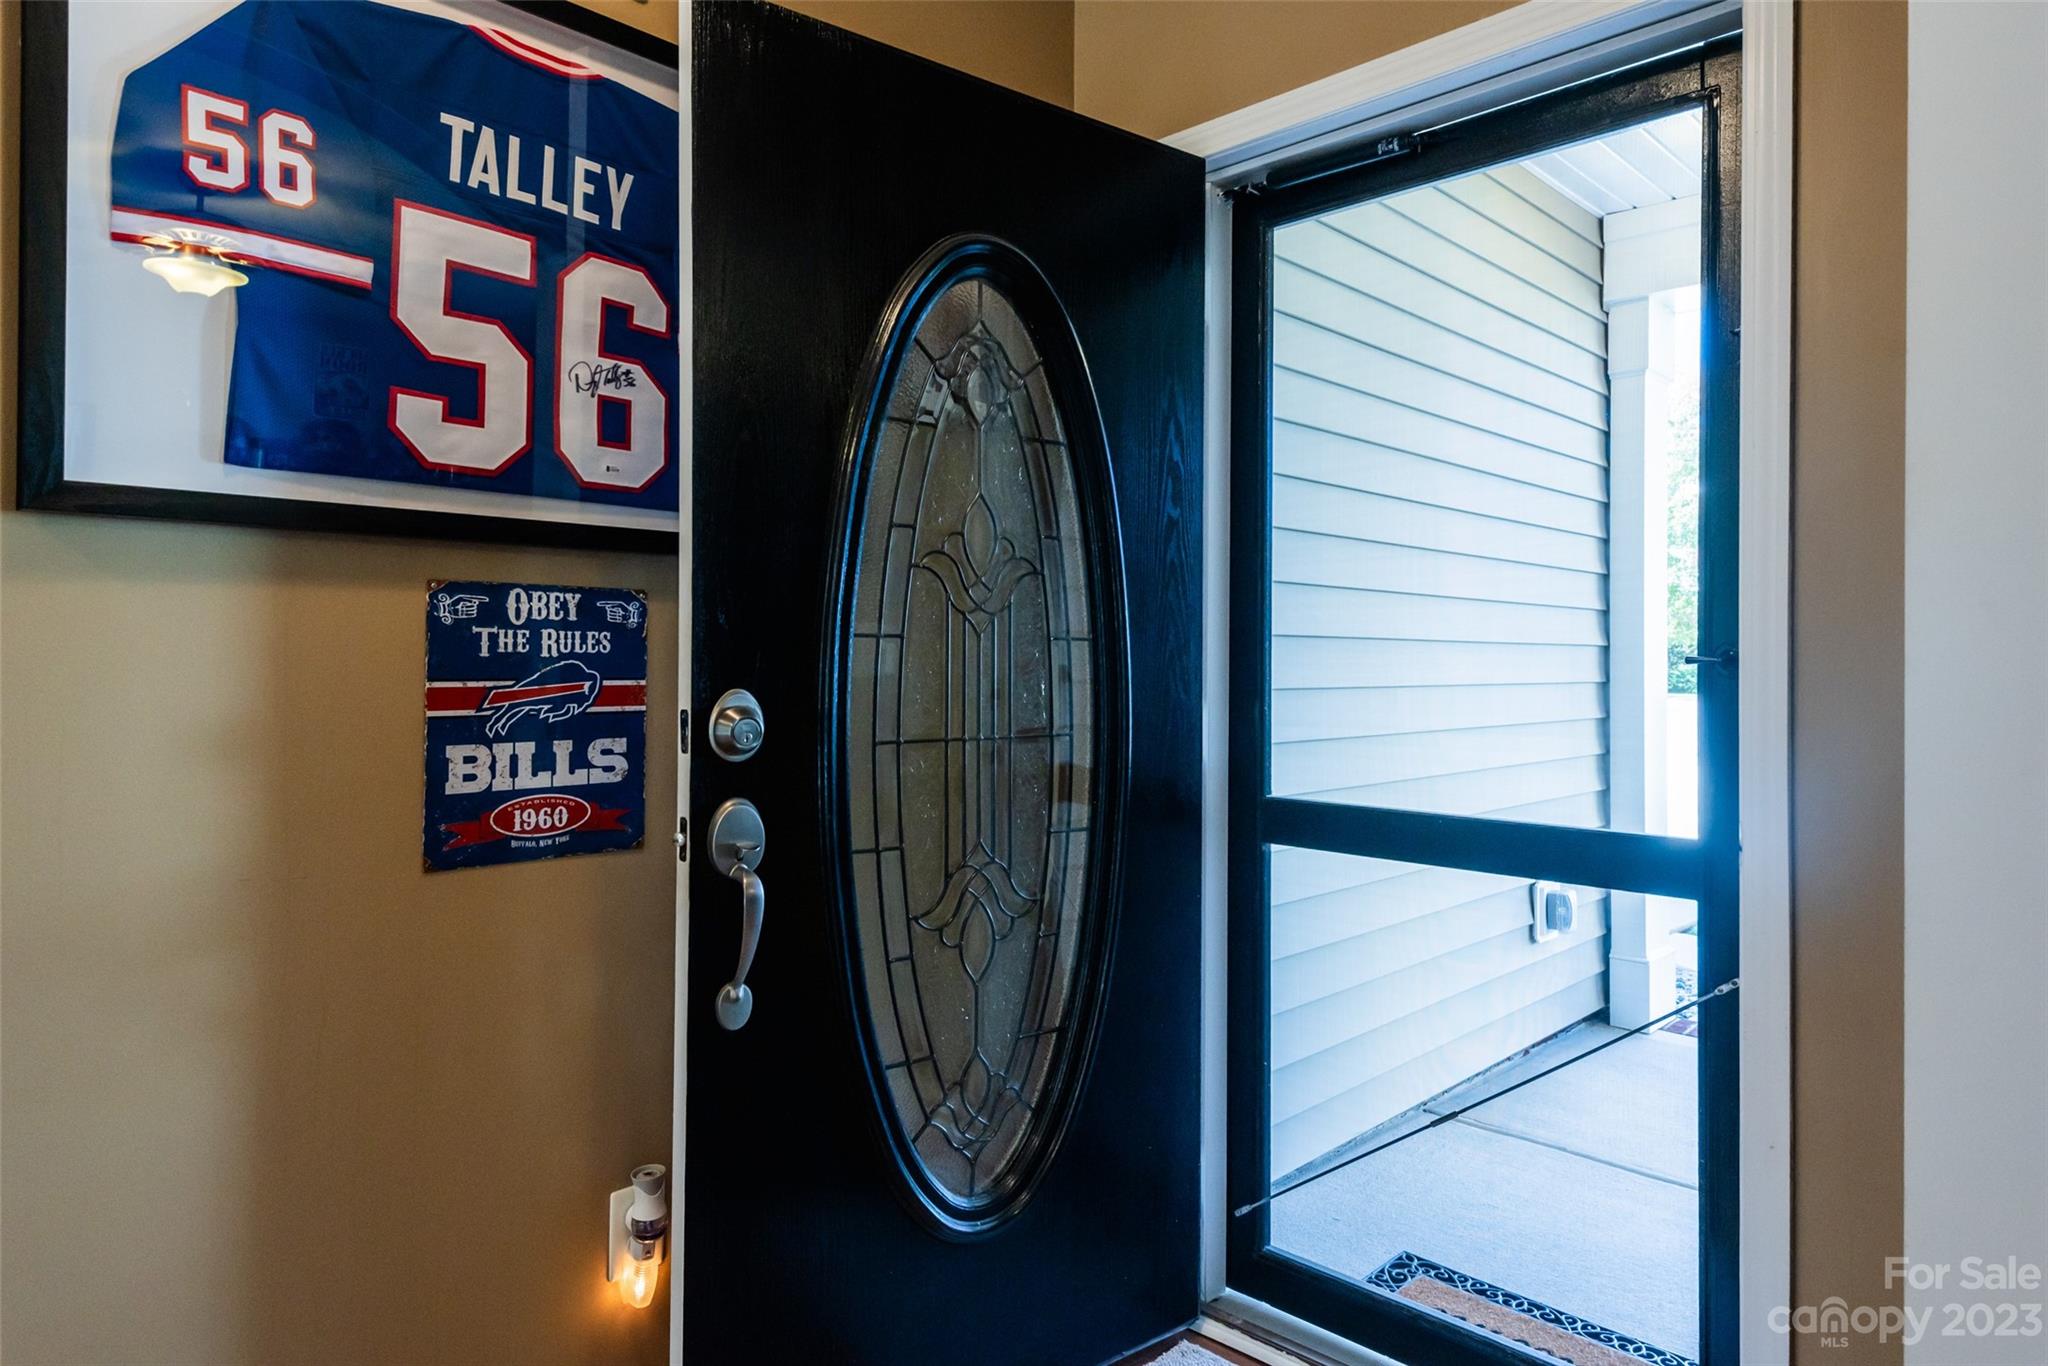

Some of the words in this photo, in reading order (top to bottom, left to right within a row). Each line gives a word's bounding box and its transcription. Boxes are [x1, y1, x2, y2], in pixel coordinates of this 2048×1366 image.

[180, 83, 317, 209] 56
[439, 112, 635, 230] TALLEY
[388, 198, 671, 493] 56
[506, 588, 581, 625] OBEY
[472, 625, 530, 657] THE
[540, 629, 612, 658] RULES
[445, 738, 629, 795] BILLS
[507, 798, 575, 811] ESTABLISHED
[513, 805, 568, 831] 1960
